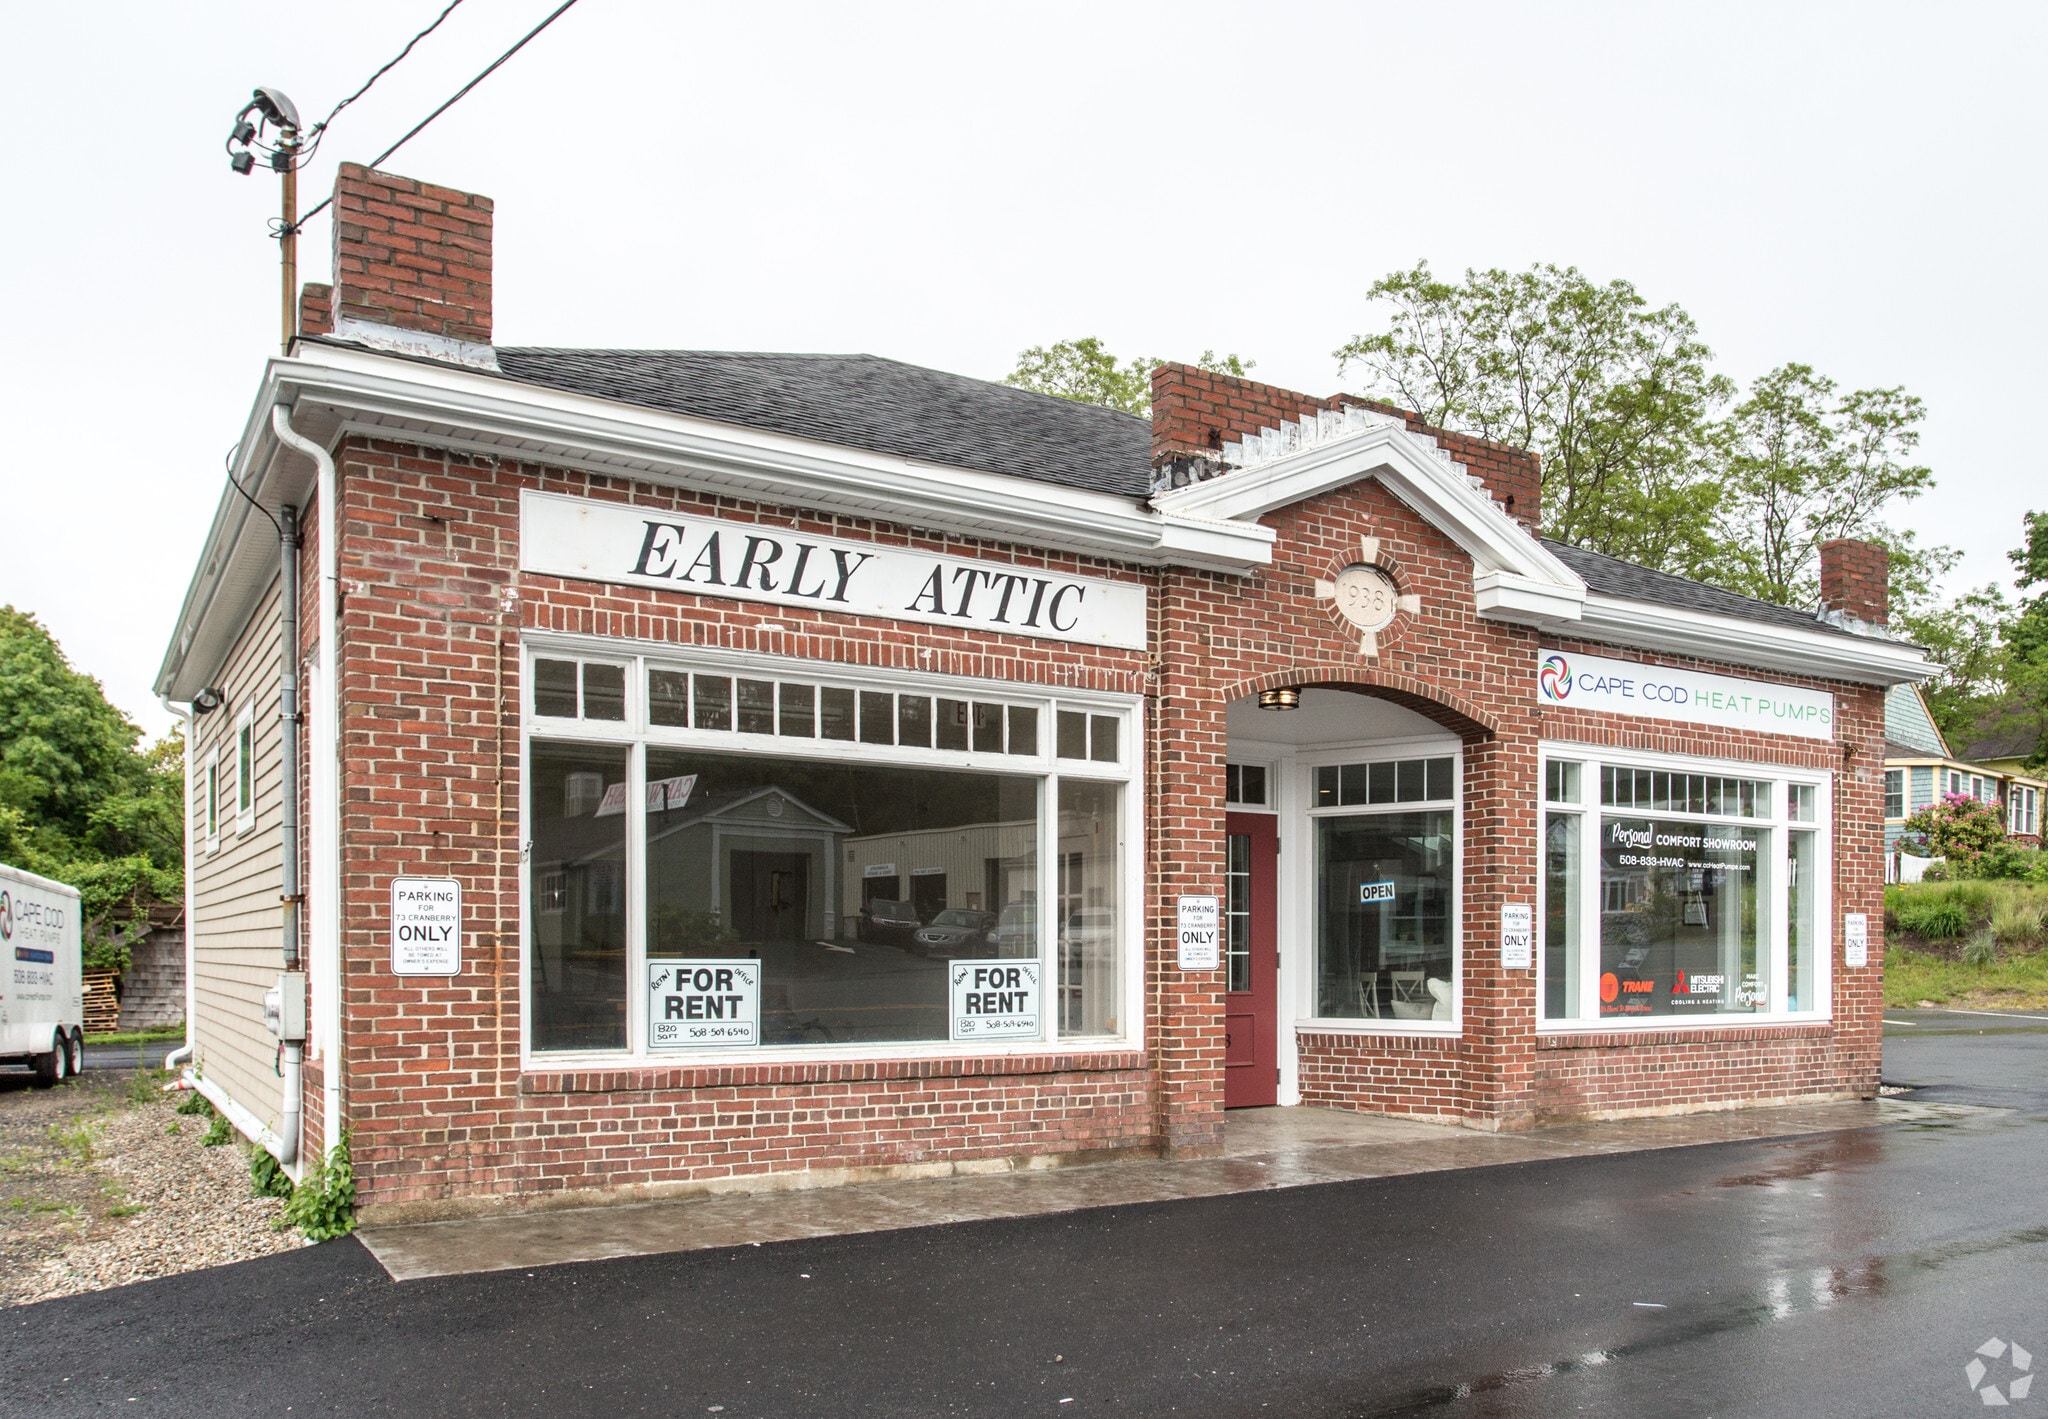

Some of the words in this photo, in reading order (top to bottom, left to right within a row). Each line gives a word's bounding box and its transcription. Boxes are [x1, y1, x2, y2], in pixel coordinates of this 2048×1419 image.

[627, 521, 873, 602] EARLY
[905, 564, 1086, 631] ATTIC
[1579, 674, 1634, 697] CAPE
[1642, 683, 1688, 704] COD
[1696, 690, 1752, 711] HEAT
[1759, 699, 1830, 724] PUMPS
[1613, 823, 1653, 849] Personal
[1656, 835, 1701, 848] COMFORT
[1703, 840, 1756, 850] SHOWROOM
[1620, 855, 1683, 867] 508-833-HVAC
[399, 892, 453, 902] PARKING
[1363, 884, 1392, 899] OPEN
[15, 900, 41, 924] CAPE
[44, 907, 64, 928] COD
[399, 926, 452, 941] ONLY
[1182, 932, 1214, 944] ONLY
[1505, 935, 1528, 945] ONLY
[1848, 939, 1864, 947] ONLY
[676, 968, 733, 991] FOR
[975, 968, 1020, 989] FOR
[1691, 975, 1724, 984] MITSUBISHI
[1623, 981, 1655, 992] TRANE
[1691, 985, 1720, 993] ELECTRIC
[966, 991, 1028, 1014] RENT
[1735, 984, 1767, 1006] Personal
[665, 995, 743, 1019] RENT
[690, 1028, 749, 1038] 508-509-6540
